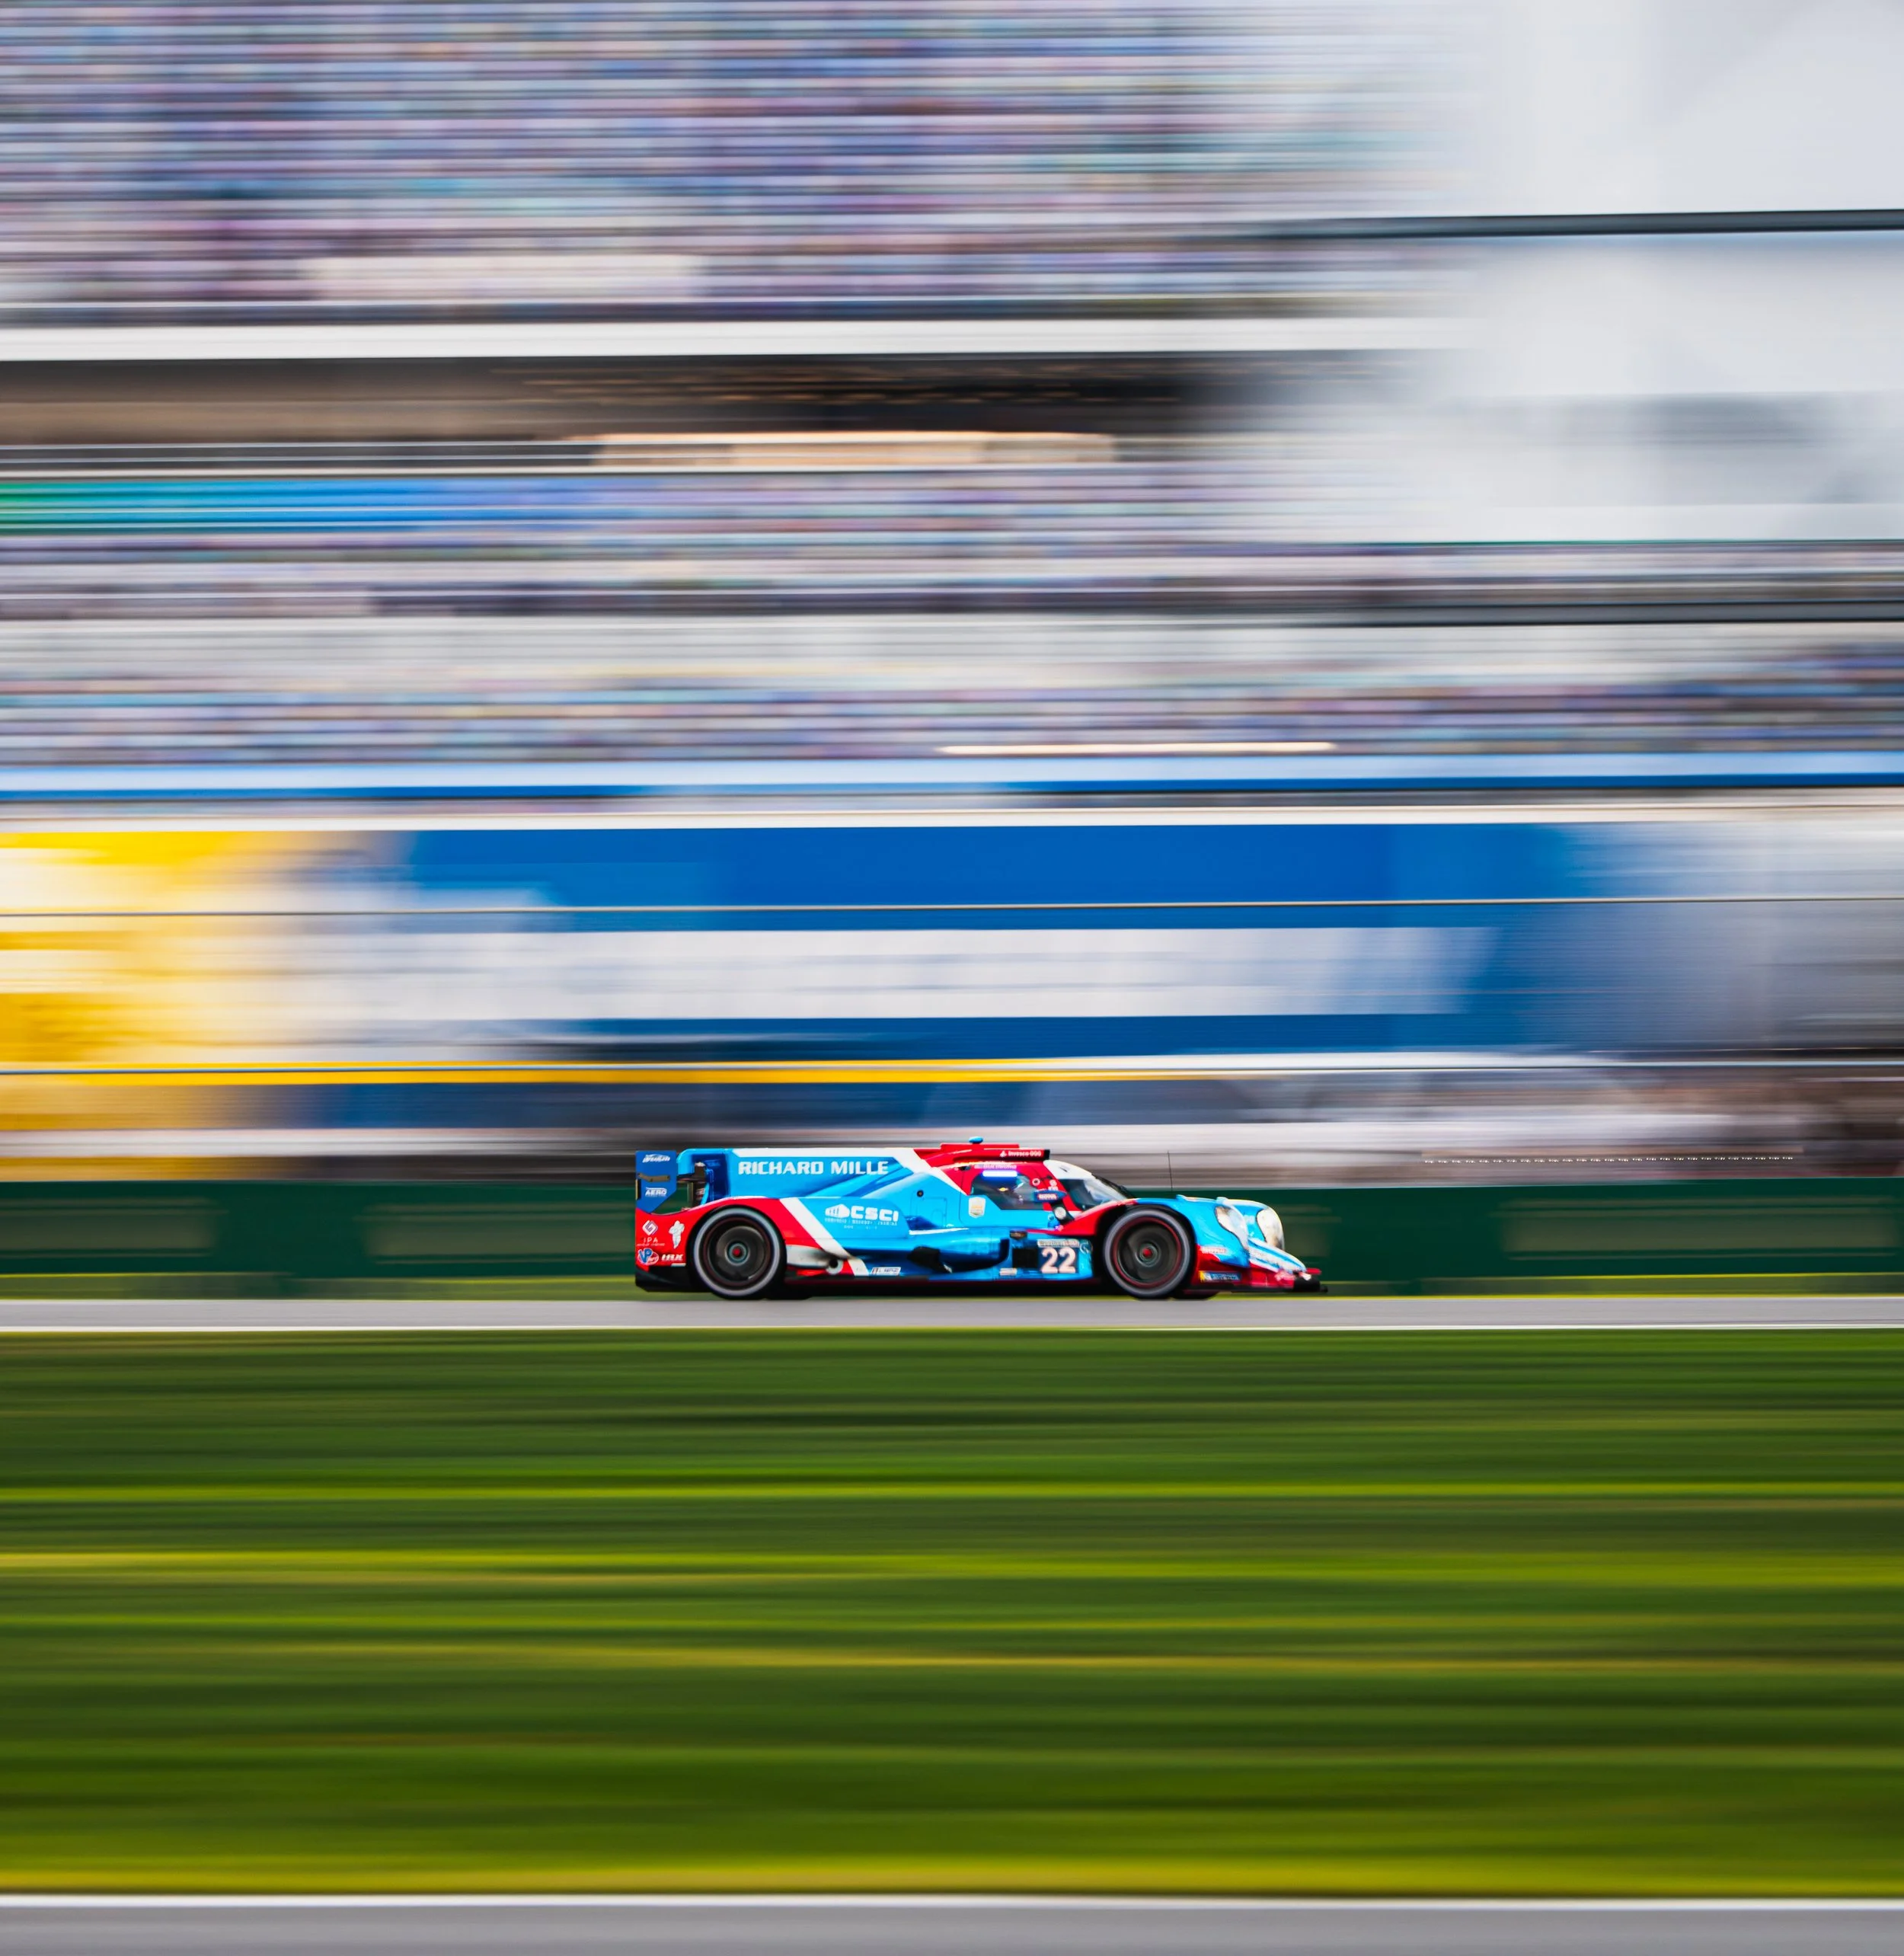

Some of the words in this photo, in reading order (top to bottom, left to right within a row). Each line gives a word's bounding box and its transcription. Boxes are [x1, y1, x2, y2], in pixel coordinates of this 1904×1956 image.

[738, 1161, 823, 1175] RICHARD
[831, 1161, 889, 1175] MILLE
[851, 1205, 899, 1222] CSCI
[1041, 1247, 1076, 1274] 22
